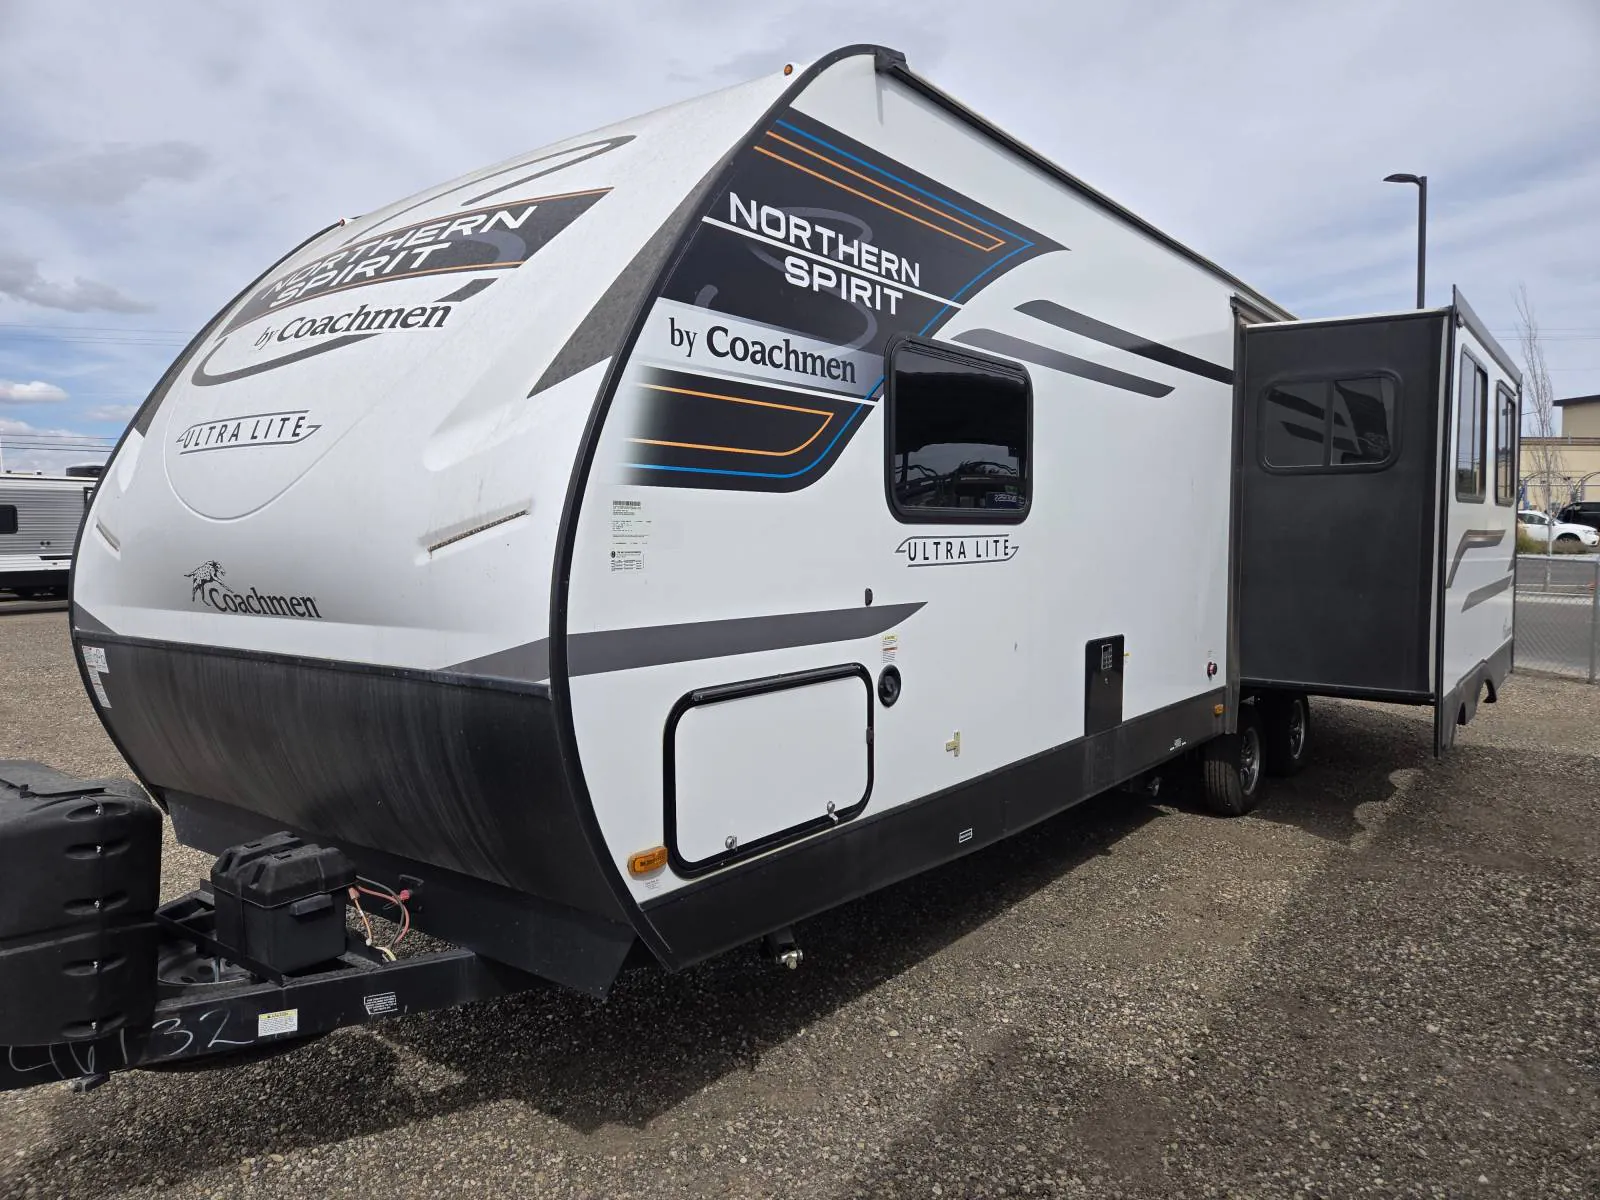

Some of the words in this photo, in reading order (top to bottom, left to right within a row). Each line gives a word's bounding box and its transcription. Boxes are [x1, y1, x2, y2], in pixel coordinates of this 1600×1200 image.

[261, 205, 538, 300] NORTHERN
[729, 192, 920, 288] NORTHERN
[269, 242, 453, 308] SPIRIT
[784, 256, 903, 315] SPIRIT
[254, 326, 279, 350] by
[276, 304, 452, 342] Coachmen
[669, 317, 697, 357] by
[706, 325, 857, 384] Coachmen
[183, 422, 242, 449] ULTRA
[250, 416, 306, 440] LITE
[907, 540, 967, 561] ULTRA
[975, 539, 1009, 558] LITE
[208, 587, 322, 619] Coachmen
